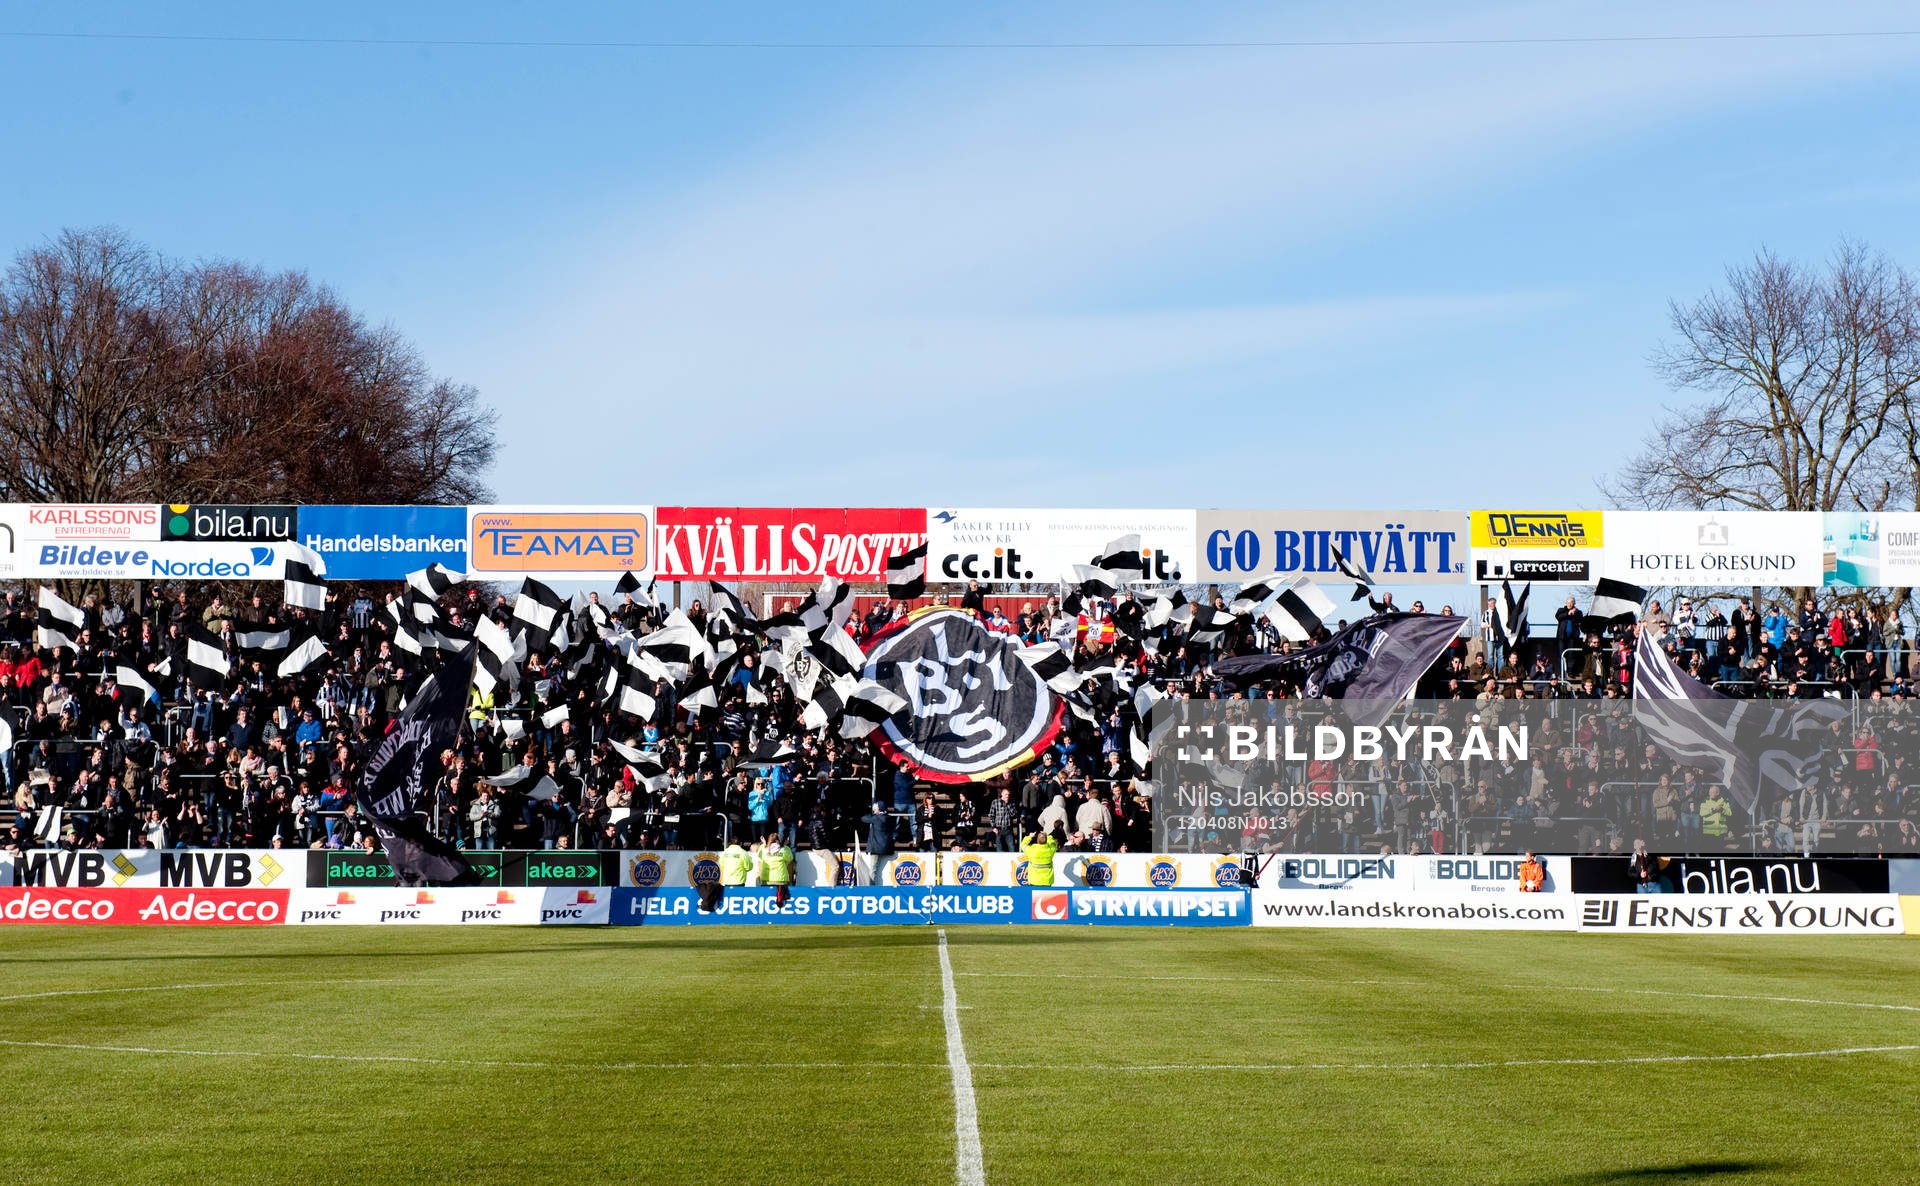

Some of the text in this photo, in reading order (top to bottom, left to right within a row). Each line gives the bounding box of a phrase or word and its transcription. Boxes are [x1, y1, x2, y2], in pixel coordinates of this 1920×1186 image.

[30, 510, 156, 524] KARLSSONS
[194, 509, 289, 537] bila.nu
[482, 518, 512, 526] www.
[953, 522, 1032, 531] BAKER TILLY
[55, 526, 131, 535] ENTREPRENAD
[953, 534, 1012, 543] SAXOS KB
[306, 534, 467, 553] Handelsbanken
[479, 528, 640, 556] TEAMAB
[1206, 529, 1260, 572] GO
[39, 545, 149, 566] Bildeve
[942, 547, 1034, 579] cc.it.
[1630, 552, 1796, 570] HOTEL ÖRESUND
[59, 568, 126, 576] www.bildeve.se
[151, 558, 250, 577] Nordea
[13, 853, 105, 887] MVB
[160, 853, 251, 887] MVB
[329, 863, 377, 878] akea
[528, 863, 576, 878] akea
[1284, 858, 1395, 879] BOLIDEN
[1437, 860, 1547, 880] BOLID
[0, 892, 115, 920] decco
[138, 892, 279, 921] Adecco
[542, 908, 582, 922] pwc
[630, 897, 689, 915] HELA
[818, 896, 1014, 915] FOTBOLLSKLUBB
[1077, 895, 1241, 917] STRYKTIPSET
[1263, 900, 1565, 920] www.landskronabois.com
[1628, 900, 1895, 928] ERNST & YOUNG
[301, 909, 341, 922] pwc
[380, 909, 421, 922] pwc
[461, 909, 501, 922] pwc
